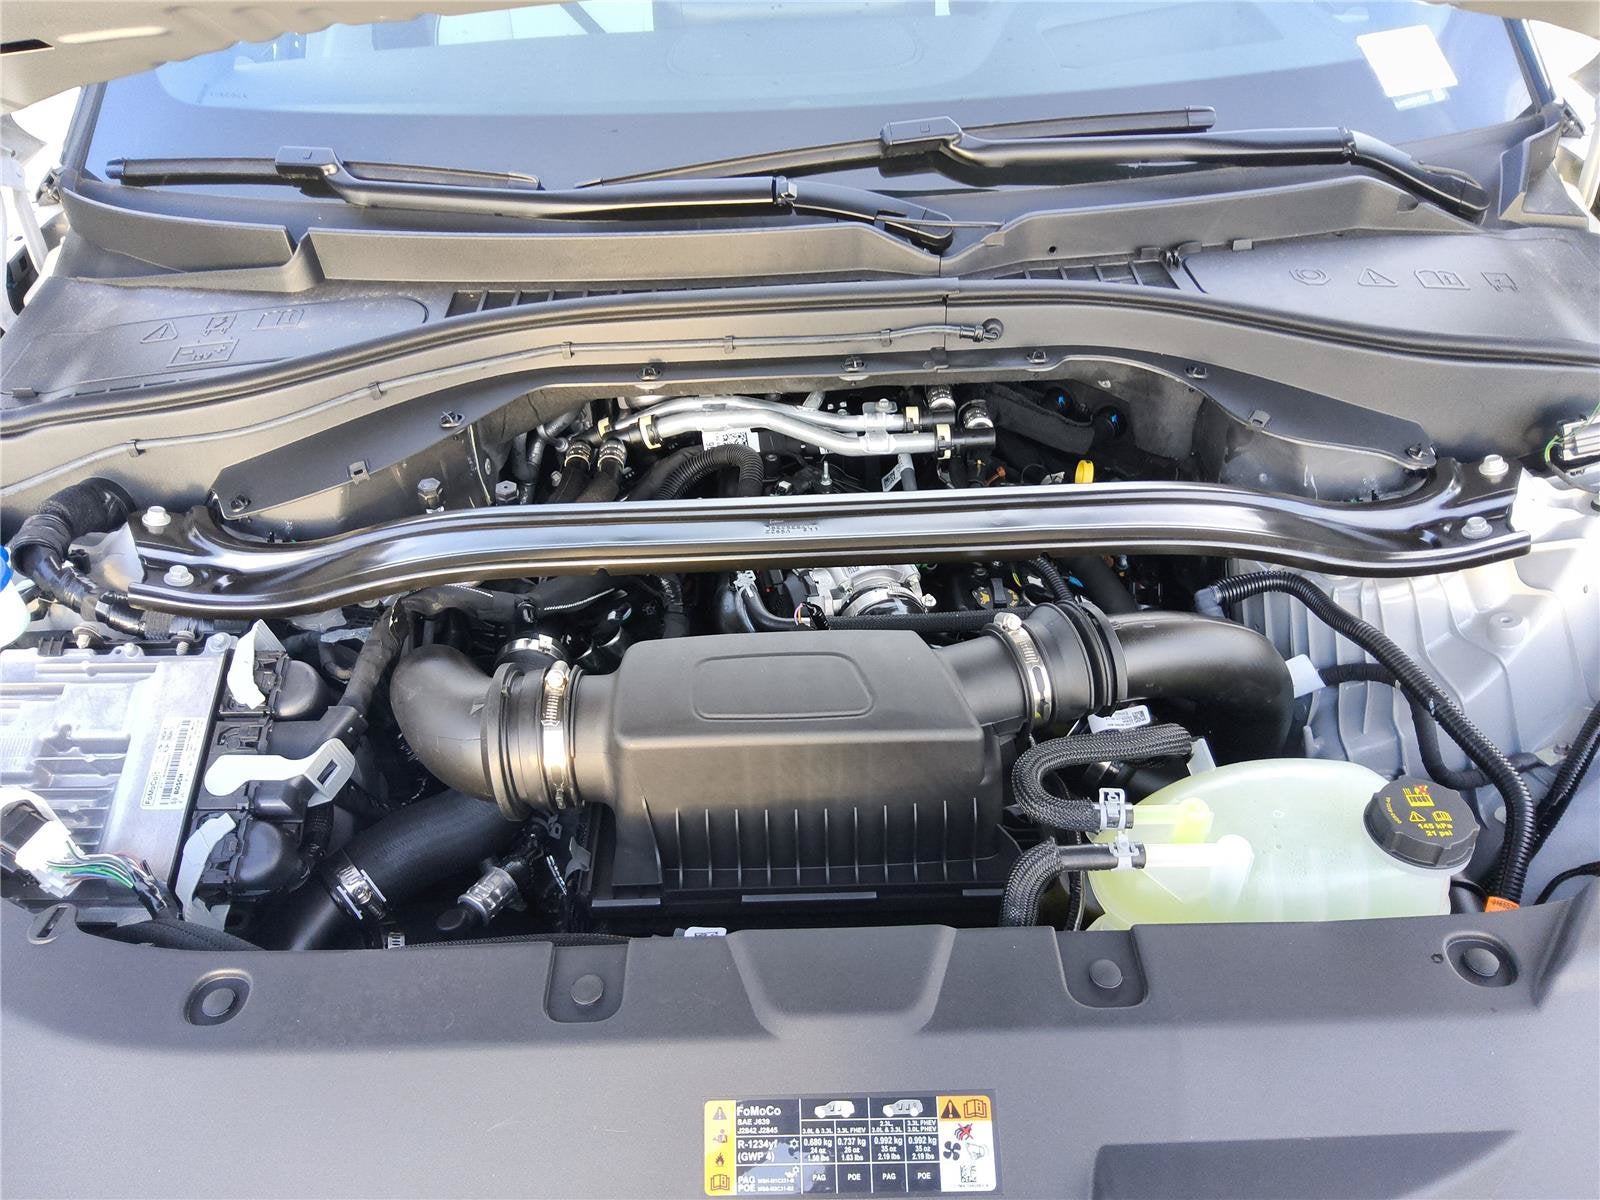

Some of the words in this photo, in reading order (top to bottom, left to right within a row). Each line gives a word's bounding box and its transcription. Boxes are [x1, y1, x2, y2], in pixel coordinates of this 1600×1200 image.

[173, 773, 185, 795] BOSCH
[1425, 829, 1437, 837] 21
[736, 1105, 782, 1117] FoMoCo
[737, 1118, 753, 1126] SAE
[737, 1139, 778, 1150] R-1234yf
[823, 1137, 833, 1148] kg
[837, 1137, 857, 1146] 0.737
[857, 1137, 867, 1147] kg
[873, 1136, 893, 1145] 0.992
[893, 1136, 903, 1147] kg
[907, 1135, 928, 1145] 0.992
[927, 1135, 938, 1146] kg
[737, 1151, 764, 1164] (GWP
[765, 1151, 776, 1163] 4)
[737, 1175, 756, 1184] PAG
[812, 1173, 827, 1182] PAG
[847, 1173, 862, 1181] POE
[882, 1172, 897, 1181] PAG
[917, 1171, 932, 1180] POE
[737, 1184, 757, 1193] POE
